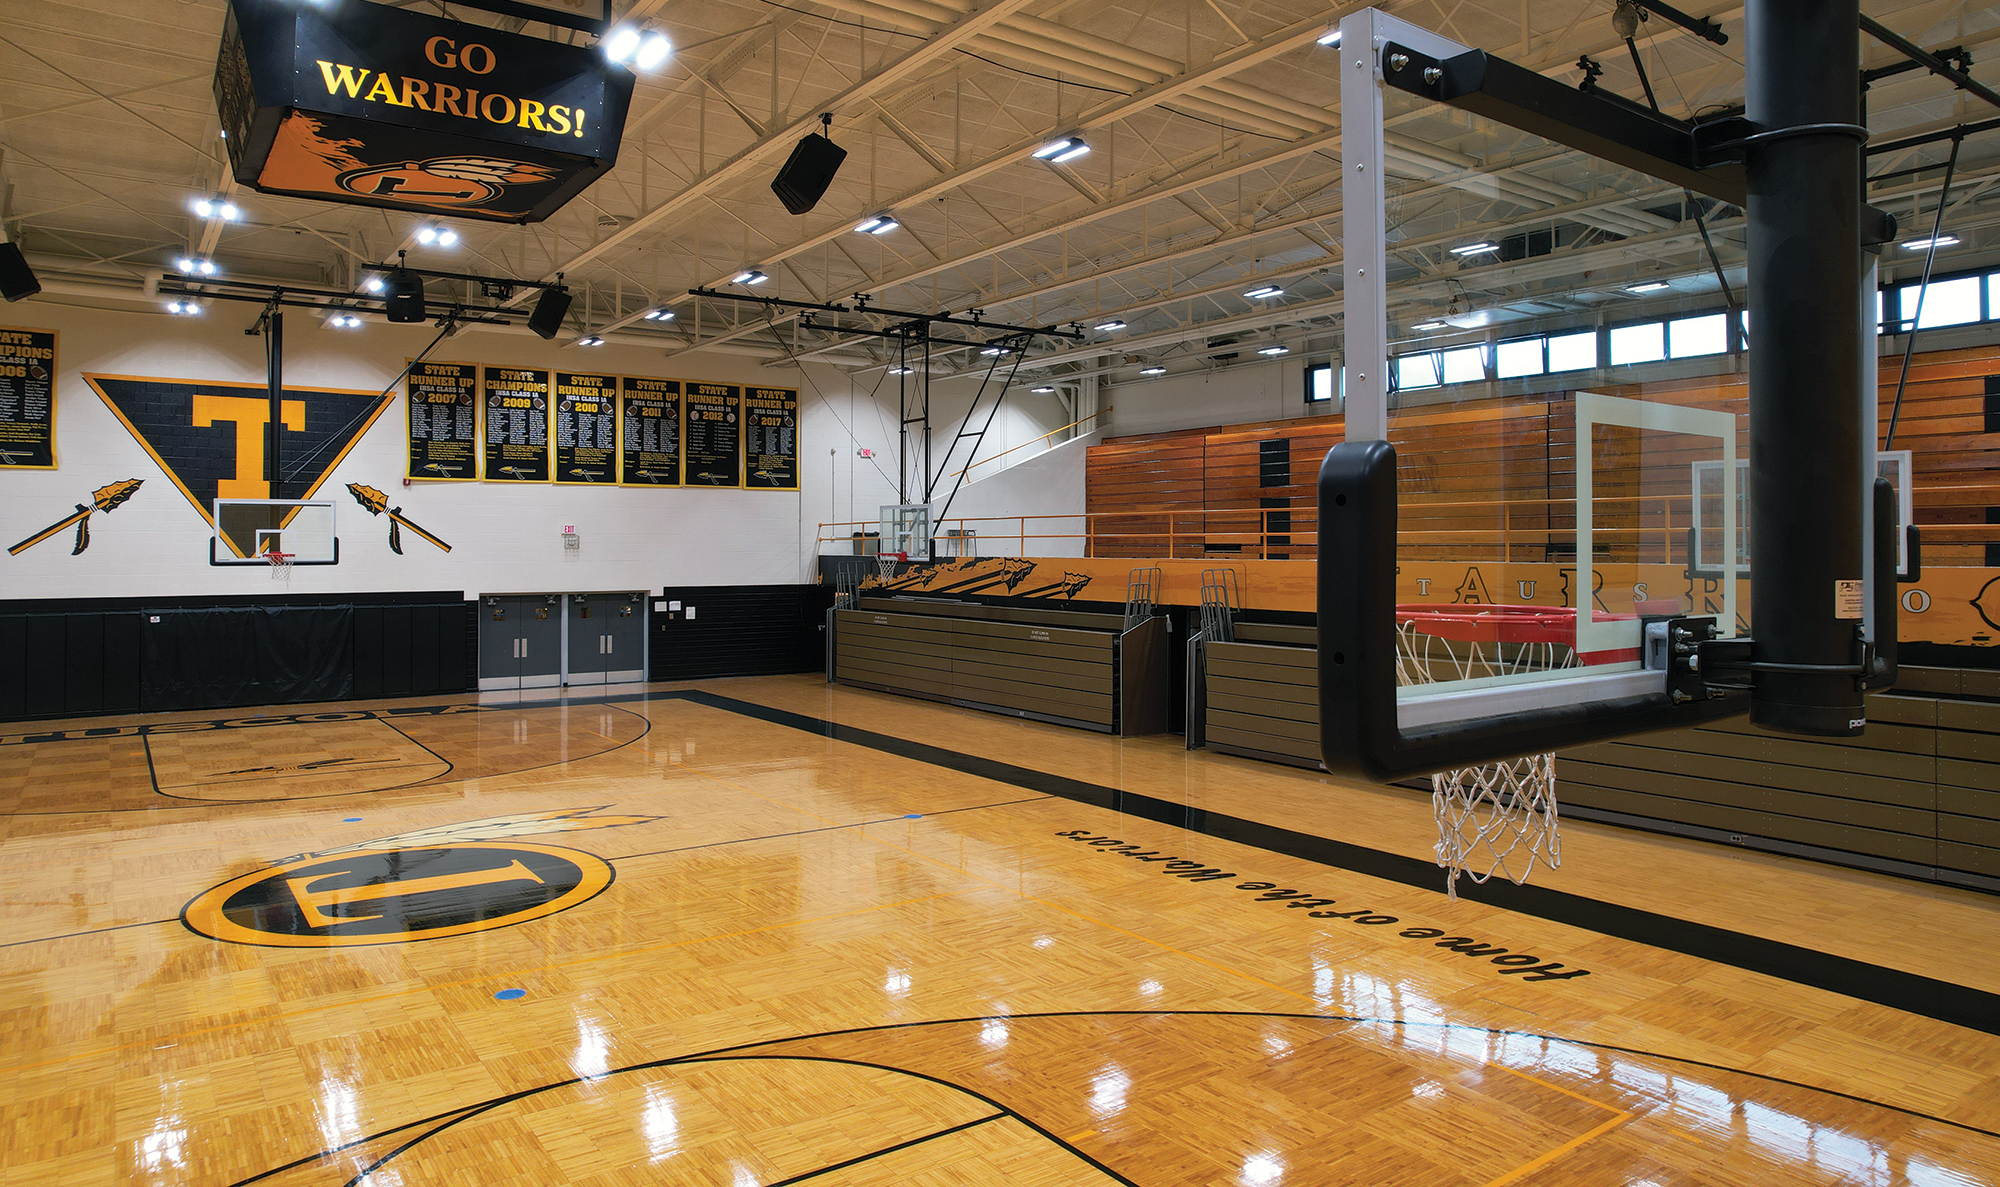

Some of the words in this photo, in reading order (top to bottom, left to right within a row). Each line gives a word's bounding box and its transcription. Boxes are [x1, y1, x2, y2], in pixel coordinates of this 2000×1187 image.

[424, 35, 497, 75] GO
[315, 59, 586, 138] WARRIORS!
[424, 365, 460, 376] STATE
[500, 370, 534, 382] STATE
[410, 375, 456, 386] RUNNER
[458, 377, 474, 388] UP
[485, 380, 548, 393] CHAMPIONS
[570, 375, 603, 387] STATE
[636, 380, 667, 391] STATE
[558, 385, 599, 397] RUNNER
[601, 388, 615, 398] UP
[624, 389, 663, 400] RUNNER
[665, 392, 679, 402] UP
[699, 385, 728, 396] STATE
[756, 389, 786, 400] STATE
[427, 393, 457, 404] 2007
[503, 397, 531, 408] 2009
[687, 394, 724, 405] RUNNER
[726, 397, 739, 406] UP
[746, 398, 782, 409] RUNNER
[784, 401, 796, 410] UP
[574, 402, 598, 413] 2010
[641, 407, 661, 417] 2011
[702, 411, 724, 421] 2012
[761, 416, 782, 426] 2017
[192, 394, 305, 500] T
[564, 525, 575, 534] EXIT
[1054, 830, 1237, 883] Warriors
[1236, 881, 1336, 908] the
[1308, 910, 1399, 926] of
[1399, 927, 1591, 982] Home
